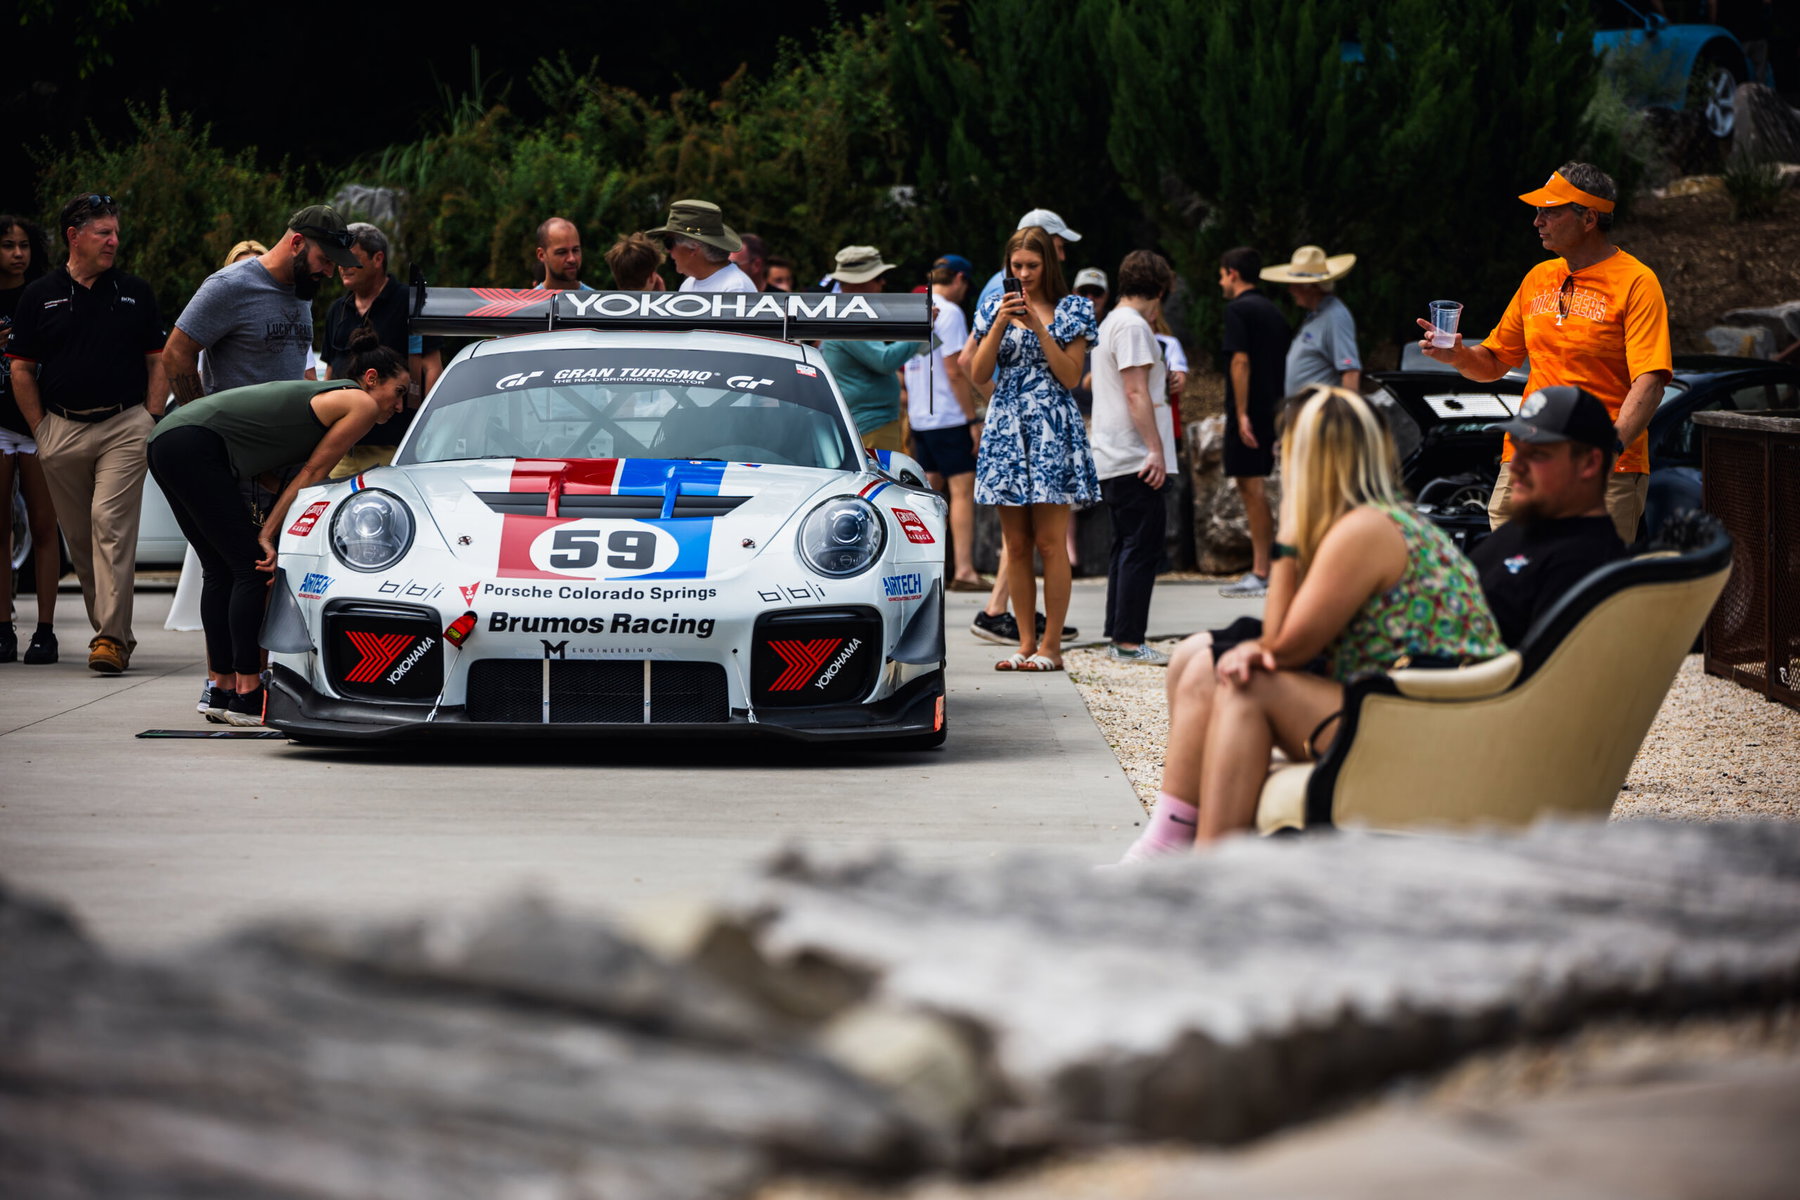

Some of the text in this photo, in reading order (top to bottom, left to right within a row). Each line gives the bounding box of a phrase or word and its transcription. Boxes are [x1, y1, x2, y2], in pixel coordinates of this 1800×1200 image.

[565, 293, 879, 319] YOKOHAMA
[554, 368, 616, 380] GRAN
[646, 377, 705, 385] SIMULATOR
[550, 530, 657, 569] 59
[484, 583, 717, 602] Porsche Colorado Springs
[882, 573, 922, 596] AIRTECH
[488, 611, 605, 634] Brumos
[610, 613, 716, 639] Racing
[386, 636, 436, 685] YOKOHAMA
[814, 638, 862, 690] YOKOHAMA
